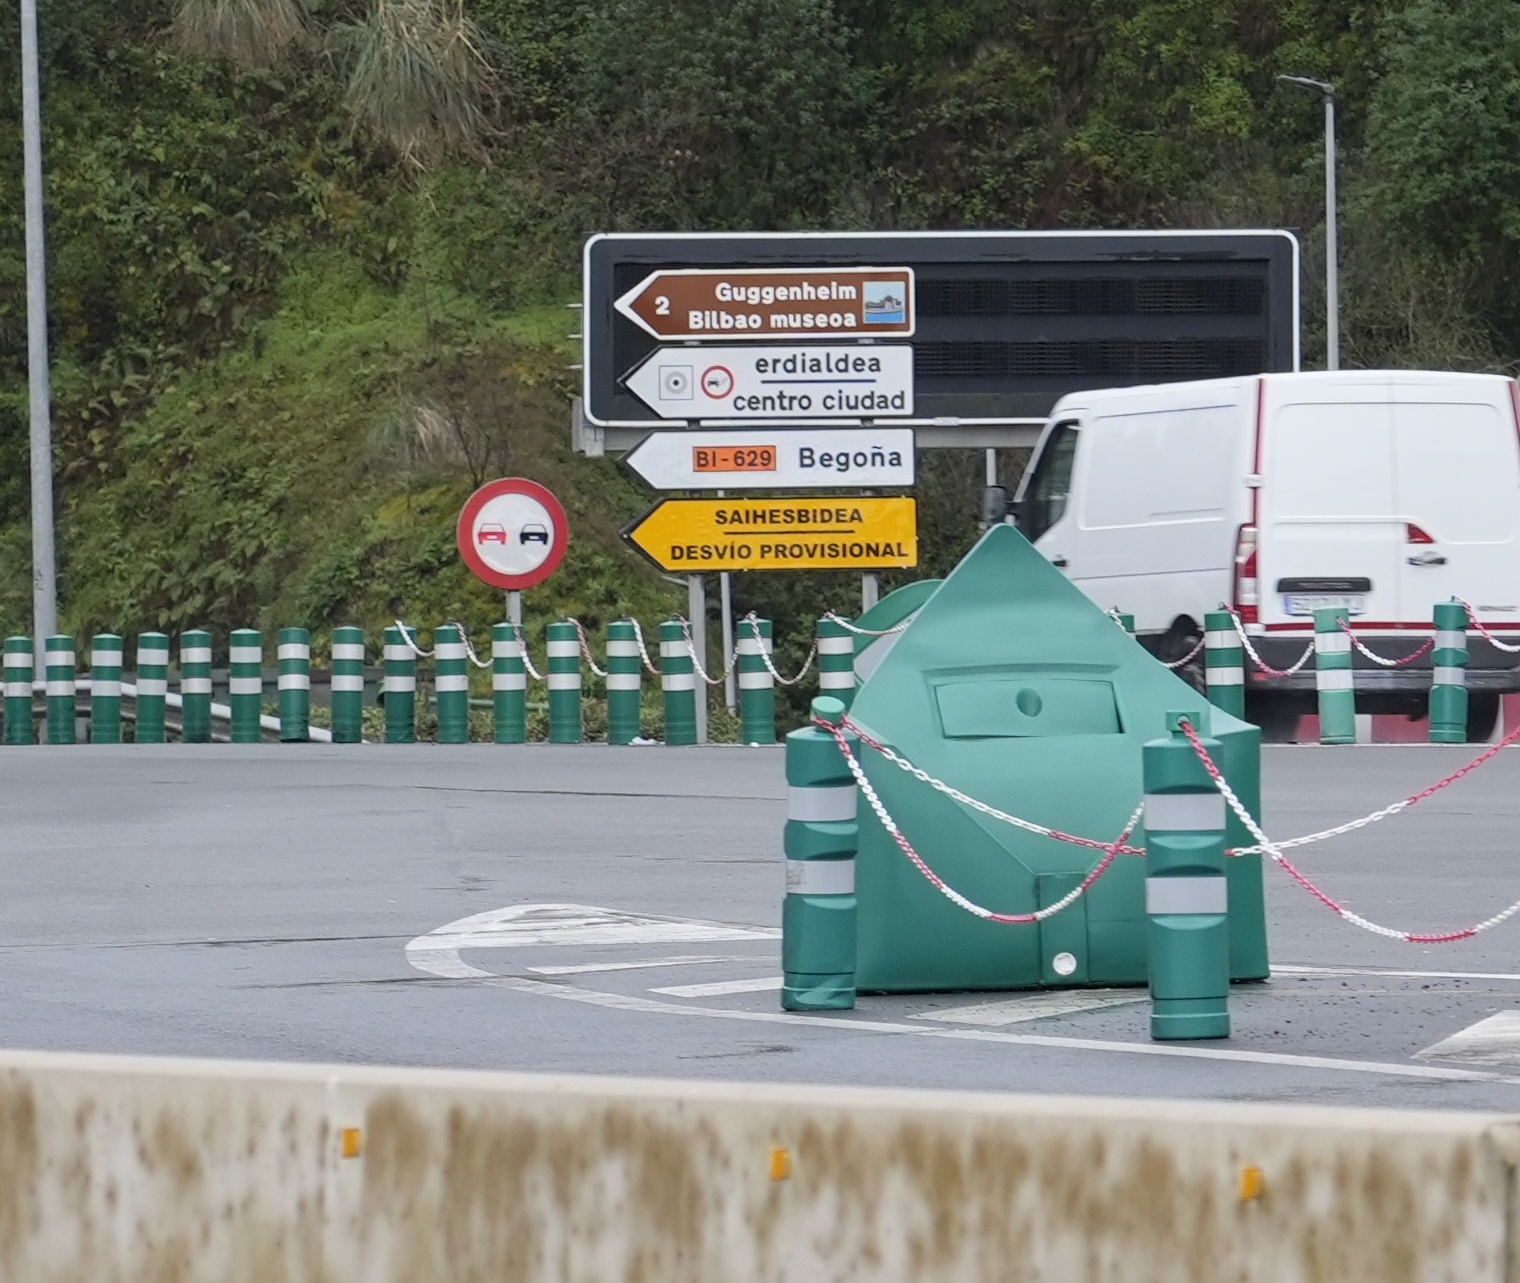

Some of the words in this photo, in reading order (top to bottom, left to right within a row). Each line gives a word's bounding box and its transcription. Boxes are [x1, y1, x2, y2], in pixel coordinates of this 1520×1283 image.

[715, 281, 857, 305] Guggenheim
[654, 297, 670, 315] 2
[689, 310, 762, 330] Bilbao
[770, 312, 857, 328] museoa
[755, 353, 882, 374] erdialdea
[733, 391, 812, 412] centro
[822, 390, 906, 410] ciudad
[799, 446, 903, 473] Begoña
[714, 509, 864, 525] SAIHESBIDEA
[671, 541, 752, 561] DESVÍO
[760, 542, 908, 560] PROVISIONAL
